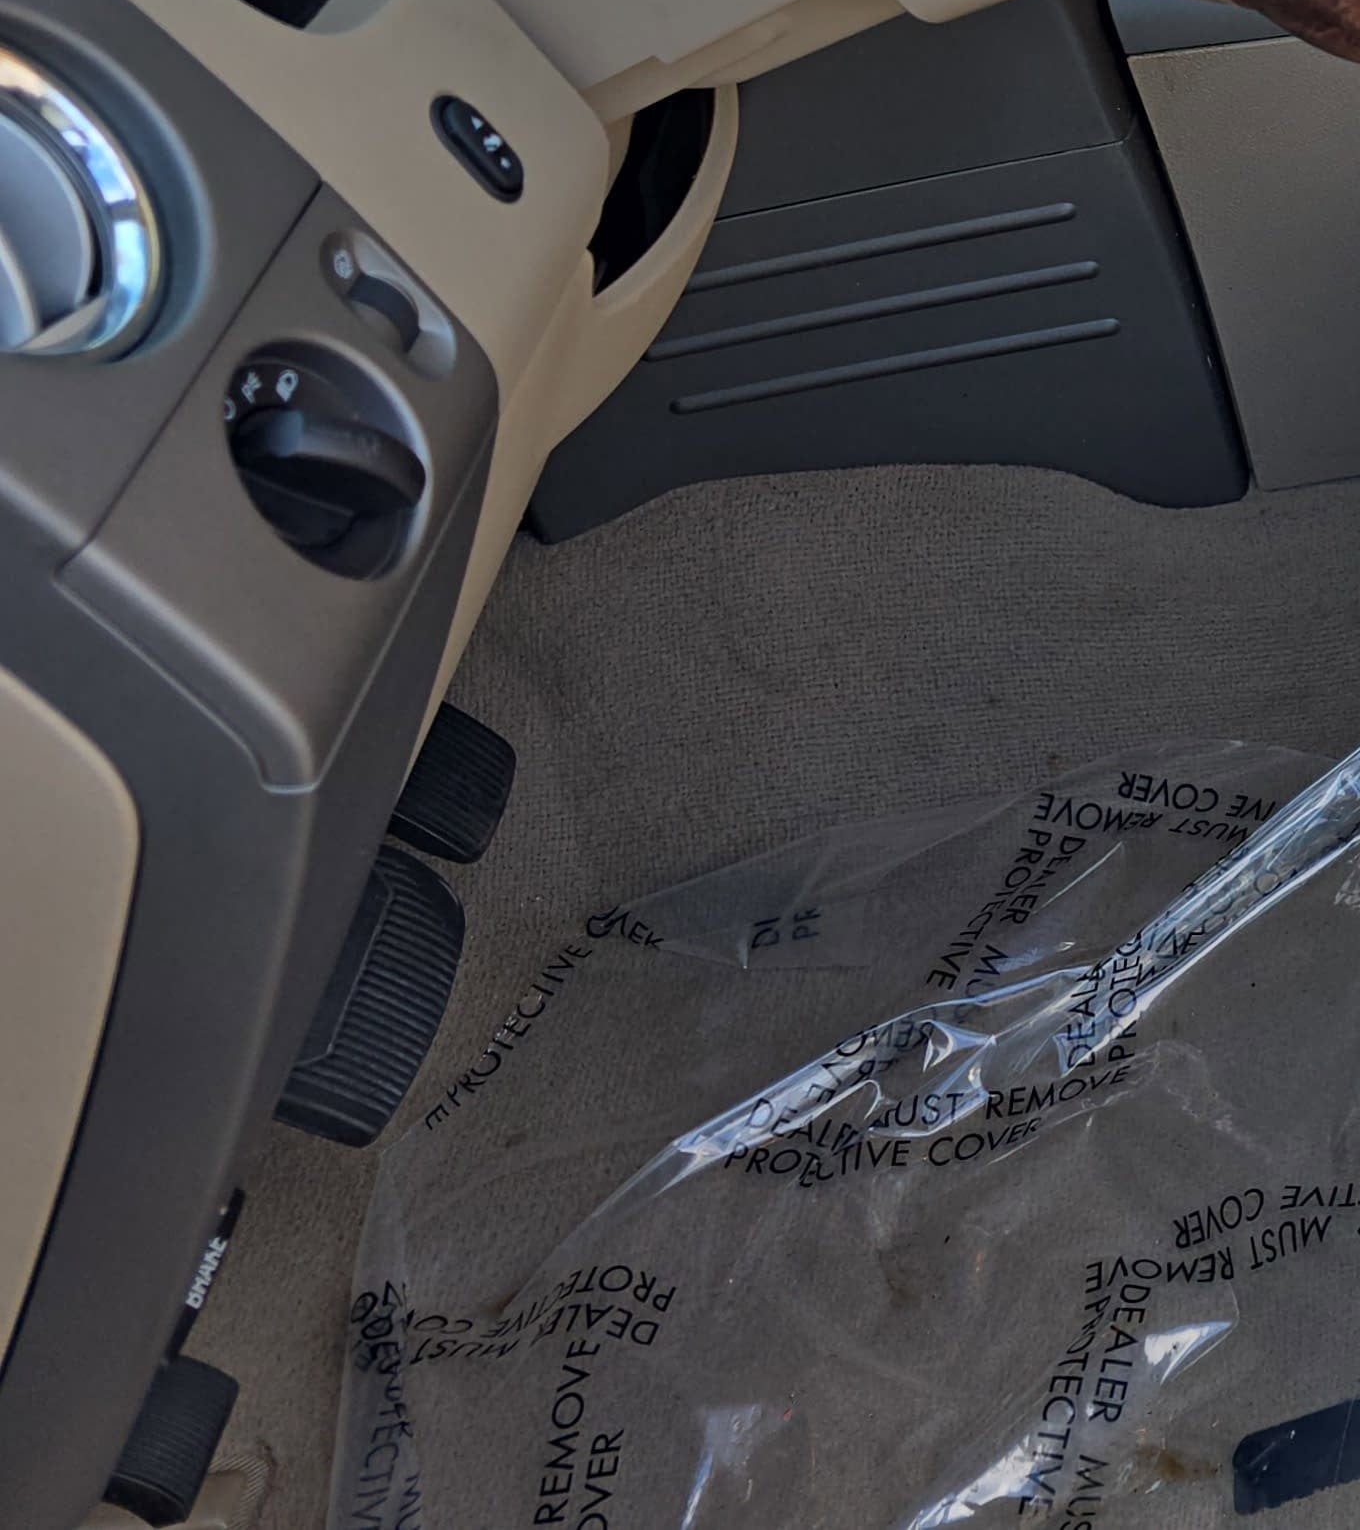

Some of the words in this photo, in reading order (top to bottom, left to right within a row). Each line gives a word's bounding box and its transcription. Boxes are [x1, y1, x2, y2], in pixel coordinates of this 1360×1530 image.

[1034, 792, 1163, 833] REMOVE
[1118, 771, 1219, 812] COVER
[986, 1065, 1131, 1120] REMOVE
[928, 1117, 1042, 1167] COVER
[1172, 1188, 1265, 1249] COVER
[1250, 1215, 1331, 1270] MUST
[1085, 1246, 1234, 1294] REMOVE
[1089, 1283, 1151, 1423] DEALER
[534, 1339, 600, 1525] REMOVE
[1018, 1294, 1112, 1516] PROTECTIVE
